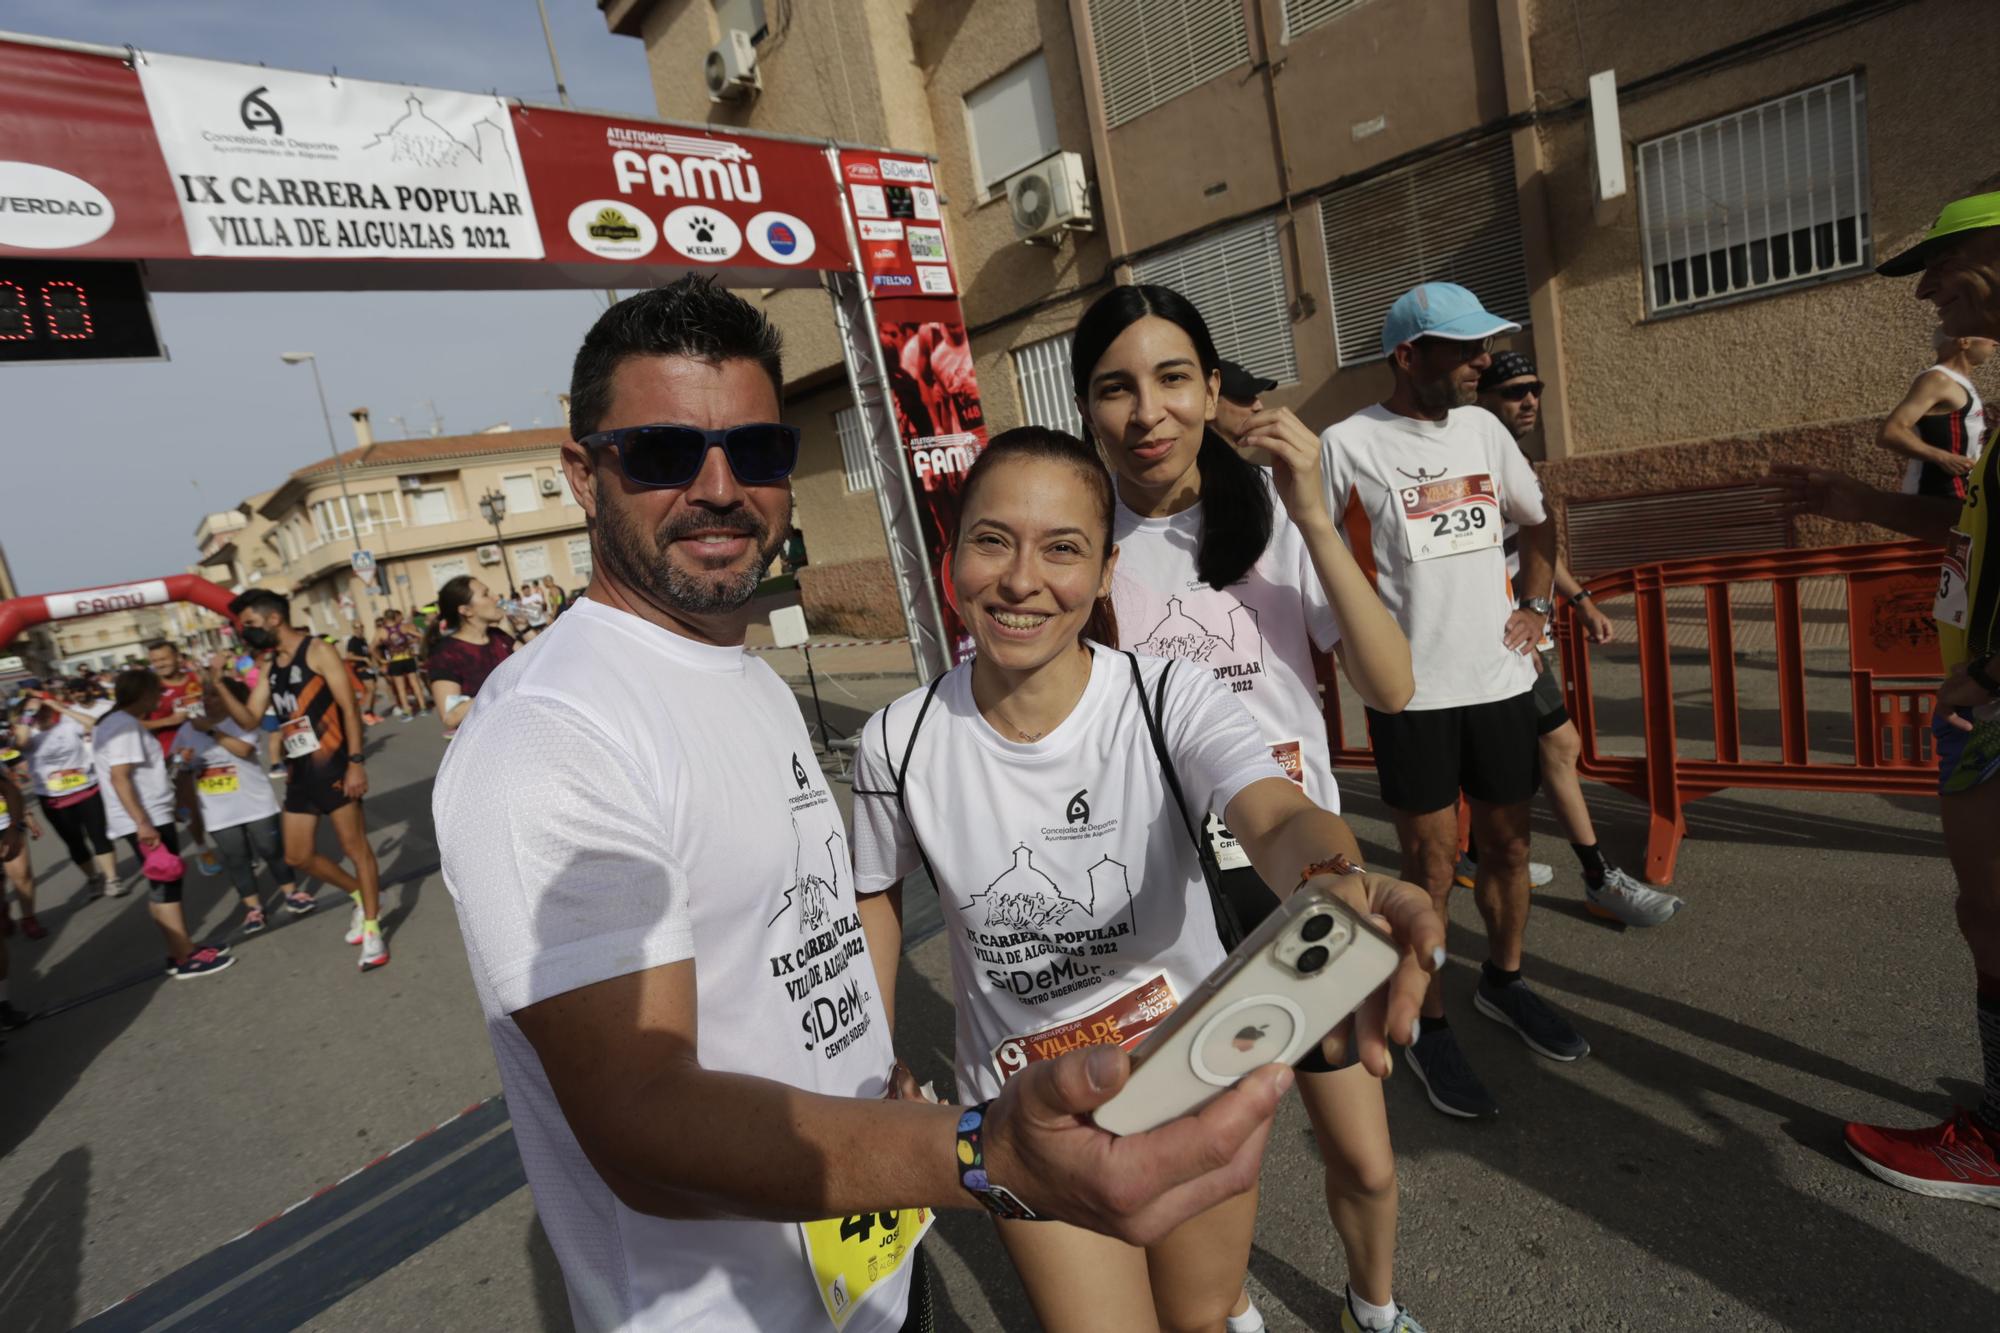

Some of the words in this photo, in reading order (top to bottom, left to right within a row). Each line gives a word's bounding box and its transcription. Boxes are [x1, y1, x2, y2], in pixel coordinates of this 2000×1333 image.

[613, 150, 762, 203] FAMU
[179, 174, 226, 203] IX
[231, 176, 391, 210] CARRERA
[395, 186, 523, 215] POPULAR
[208, 216, 293, 246] VILLA
[294, 218, 331, 246] DE
[337, 219, 454, 249] ALGUAZAS
[463, 226, 510, 249] 2022
[686, 245, 728, 256] KELME
[1430, 507, 1486, 537] 239
[1212, 661, 1261, 680] OPULAR
[1231, 680, 1254, 693] 2022
[1088, 819, 1118, 831] Deportes
[980, 931, 1052, 948] CARRERA
[1054, 922, 1130, 944] POPULAR
[974, 946, 1006, 964] VILLA
[1006, 951, 1023, 964] DE
[1025, 943, 1085, 961] ALGUAZAS
[1090, 942, 1118, 957] 2022
[770, 953, 795, 977] IX
[986, 958, 1101, 995] SiDeMur
[1147, 990, 1168, 1005] MAYO
[1143, 999, 1174, 1022] 2022
[1033, 1029, 1091, 1057] VILLA
[1091, 1015, 1118, 1039] DE
[1055, 1022, 1082, 1036] POPULAR
